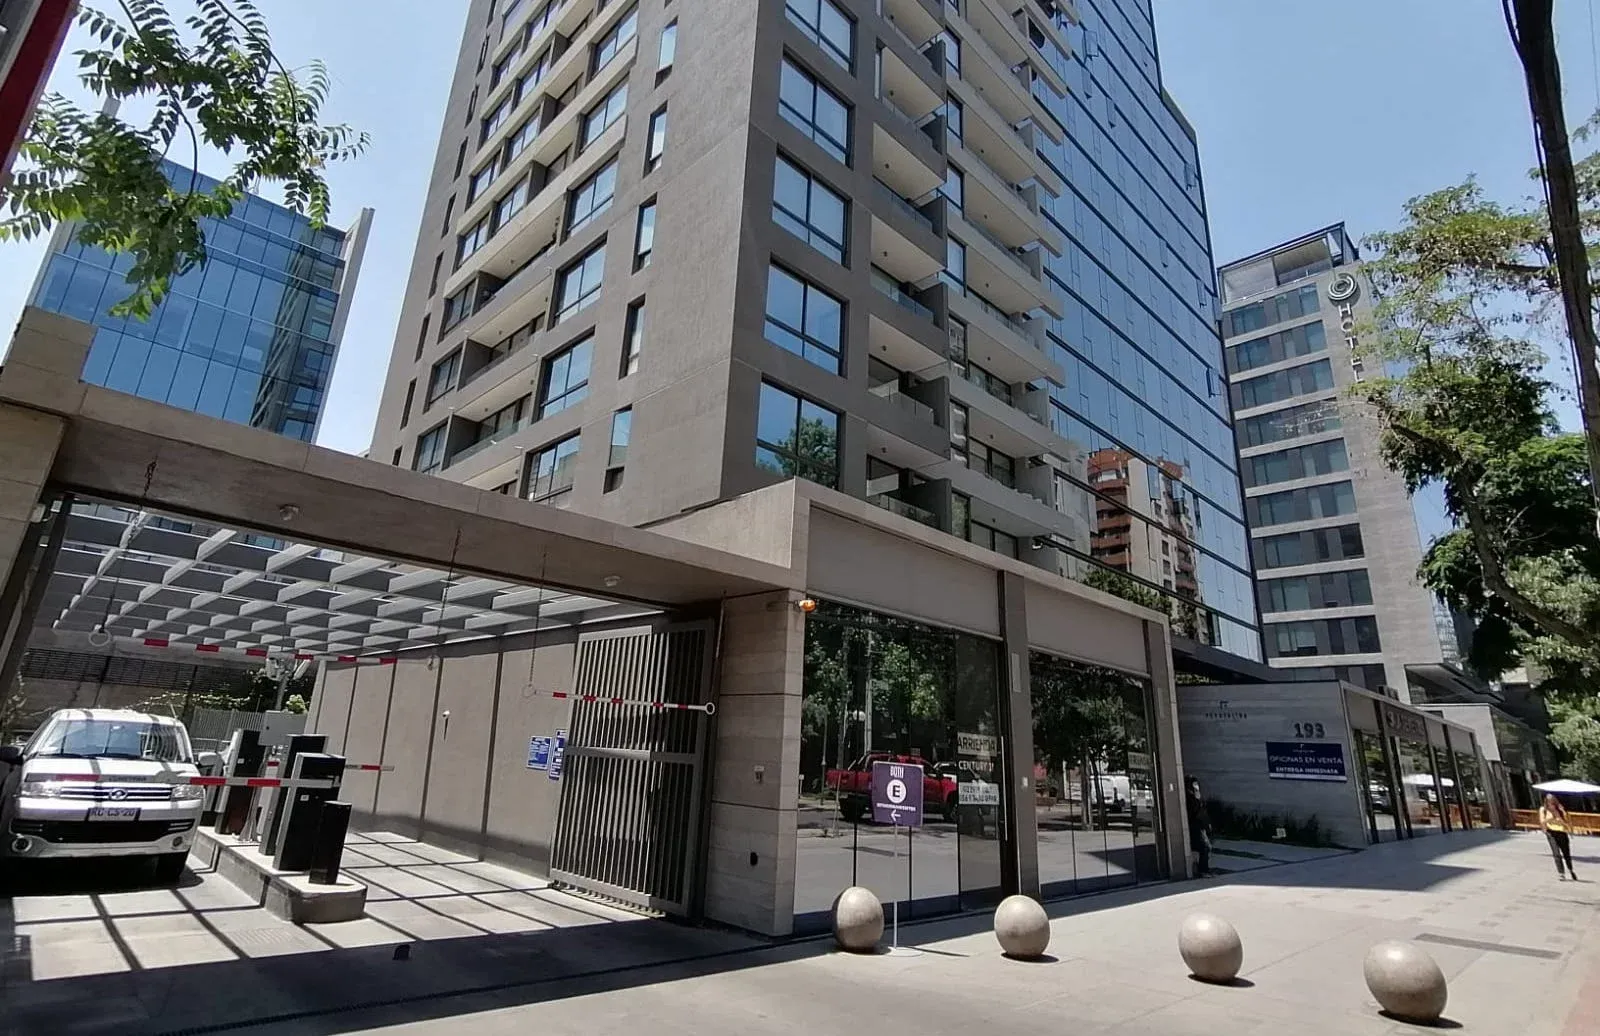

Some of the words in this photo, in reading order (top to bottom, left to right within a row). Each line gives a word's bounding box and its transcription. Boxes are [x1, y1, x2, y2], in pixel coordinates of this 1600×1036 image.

[1338, 303, 1364, 382] HOTEL
[1294, 722, 1325, 738] 193
[892, 785, 901, 797] E
